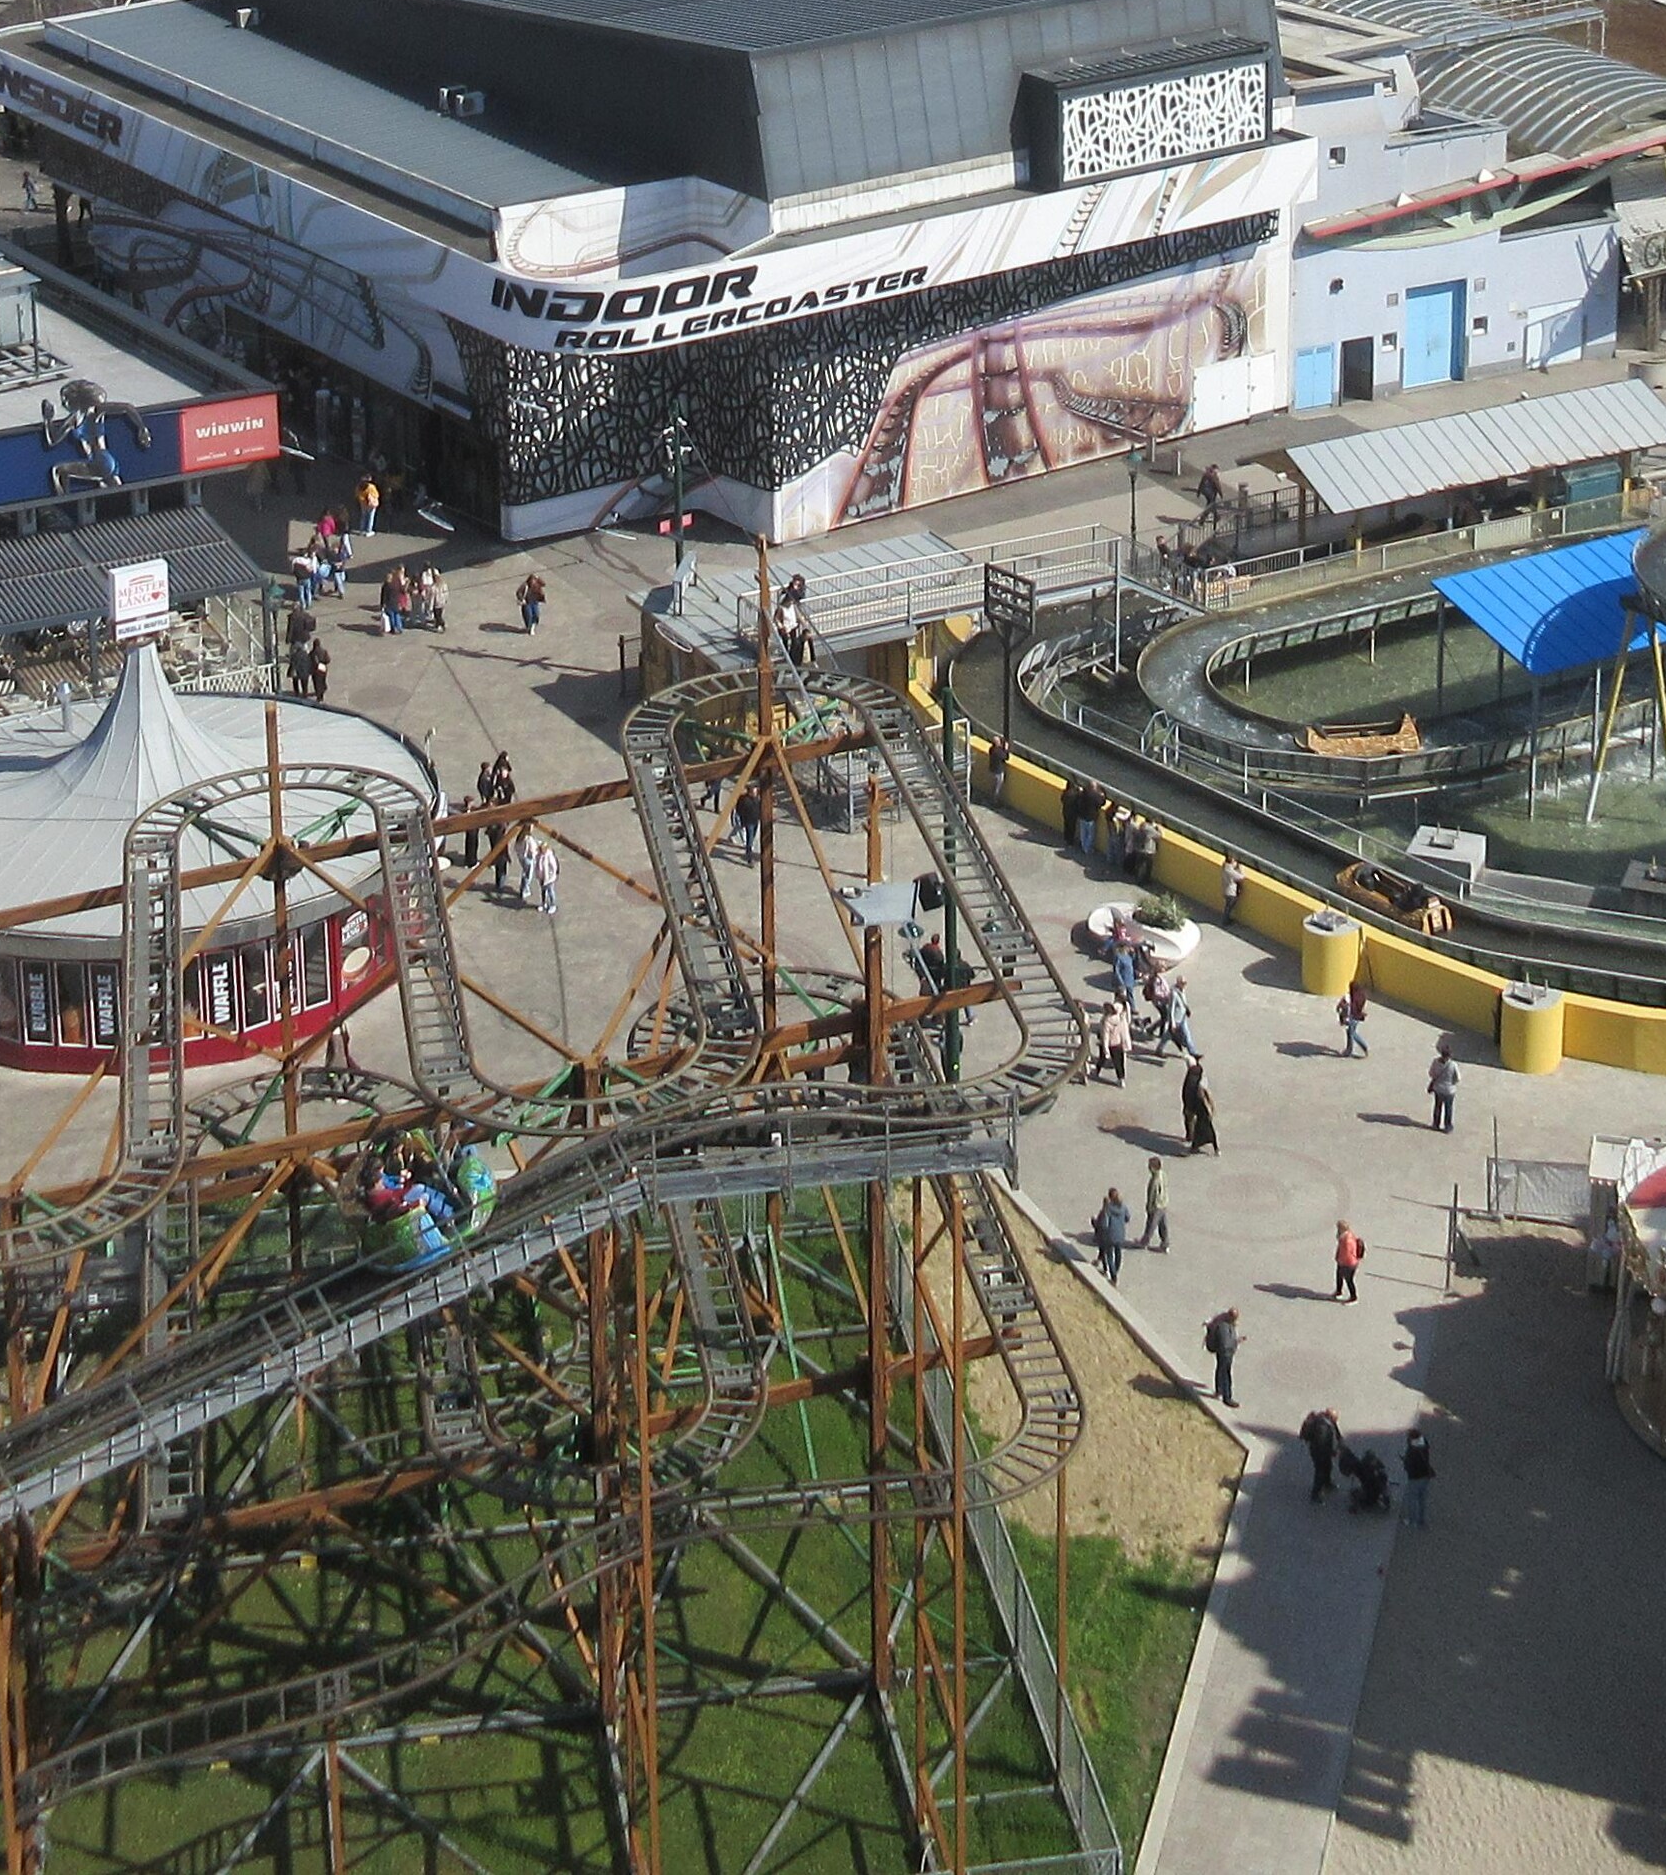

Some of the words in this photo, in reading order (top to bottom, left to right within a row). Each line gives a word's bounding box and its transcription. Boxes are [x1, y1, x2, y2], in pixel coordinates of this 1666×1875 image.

[490, 264, 758, 324] INDOOR
[553, 266, 928, 350] ROLLERCOASTER
[29, 972, 47, 1032] BUBBLE
[97, 973, 116, 1036] WAFFLE
[212, 961, 231, 1025] WAFFLE
